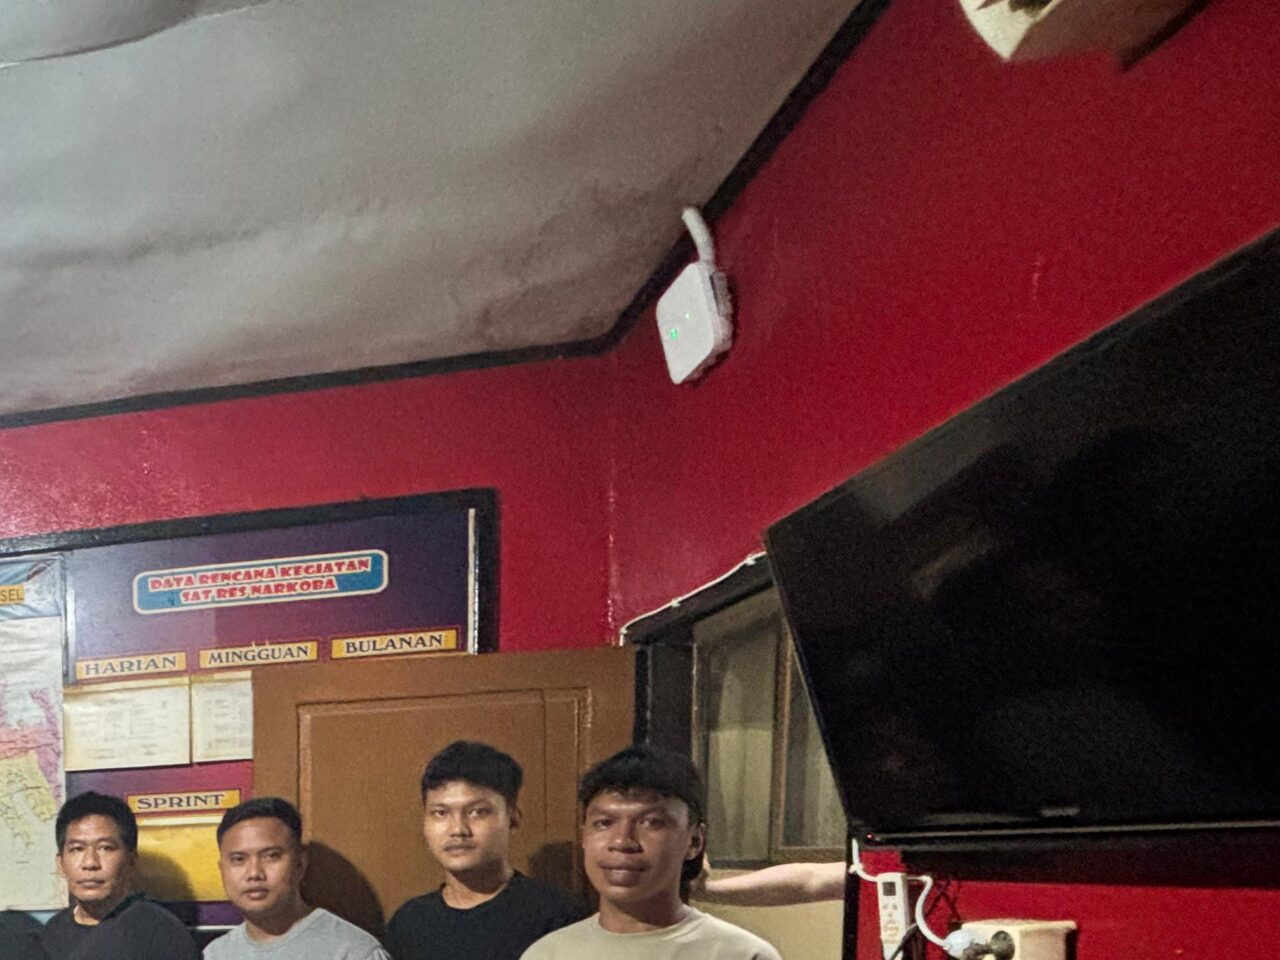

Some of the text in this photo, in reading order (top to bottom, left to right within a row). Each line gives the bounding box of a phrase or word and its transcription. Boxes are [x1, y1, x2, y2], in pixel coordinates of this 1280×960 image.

[150, 559, 370, 590] DATA RENCANA KEGIATAN
[182, 578, 336, 602] SAT RES NARKOBA
[345, 633, 443, 654] BULANAN
[208, 645, 309, 664] MINGGUAN
[85, 655, 177, 676] HARIAN
[137, 793, 225, 810] SPRINT
